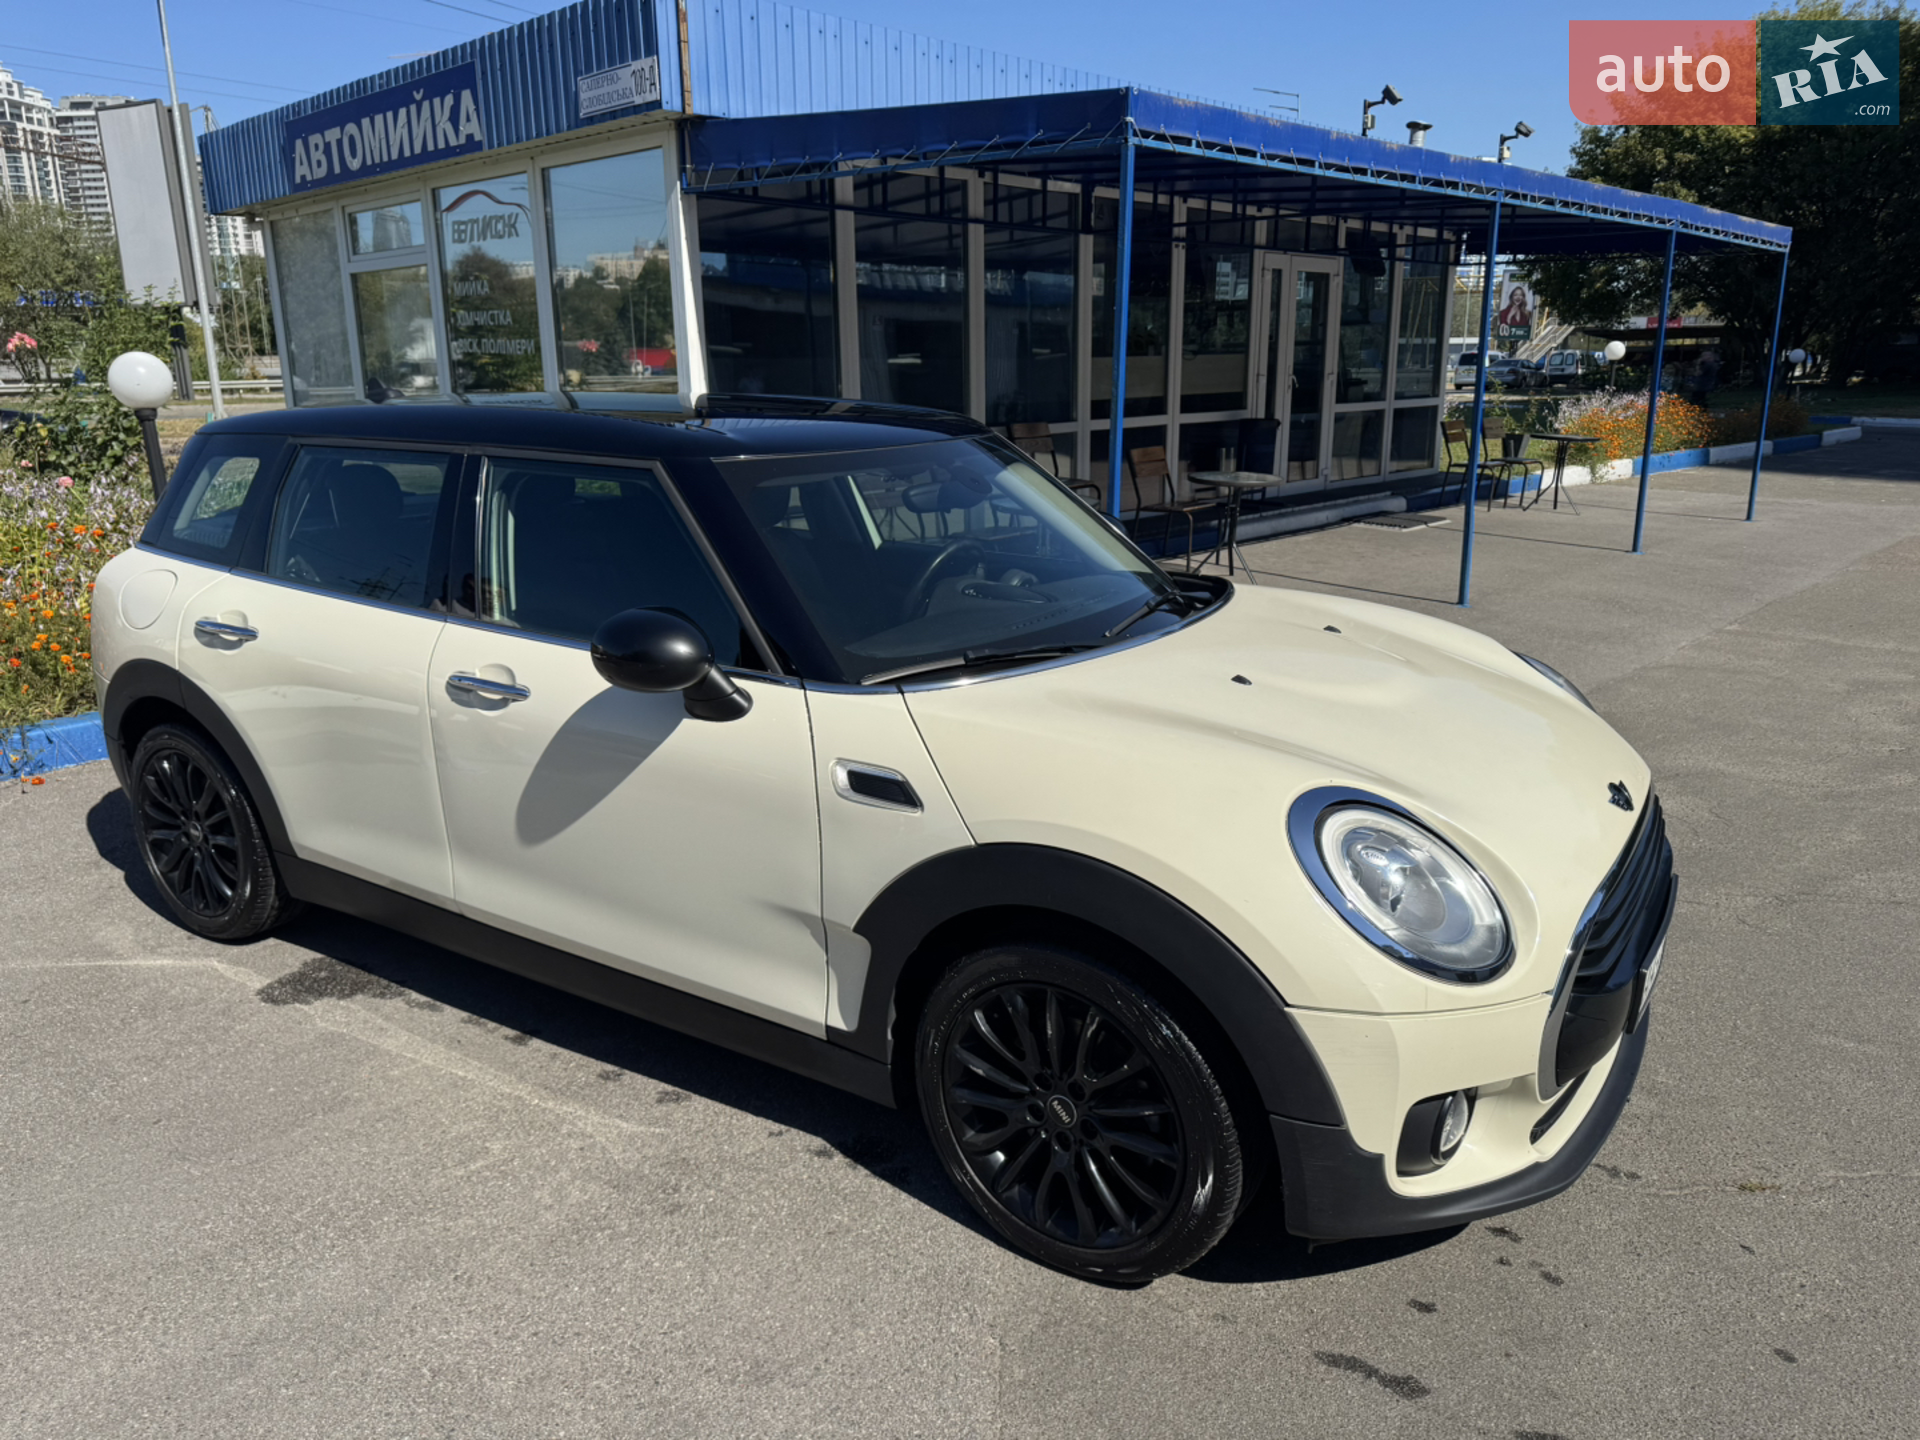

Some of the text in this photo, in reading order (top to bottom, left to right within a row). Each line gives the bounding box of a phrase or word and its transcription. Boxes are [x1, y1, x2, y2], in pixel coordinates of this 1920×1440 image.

[580, 71, 622, 95] САПЕРНО-
[294, 88, 484, 184] АВТОМИЙКА
[453, 276, 490, 297] МИЙКА
[1052, 1100, 1071, 1122] MINI
